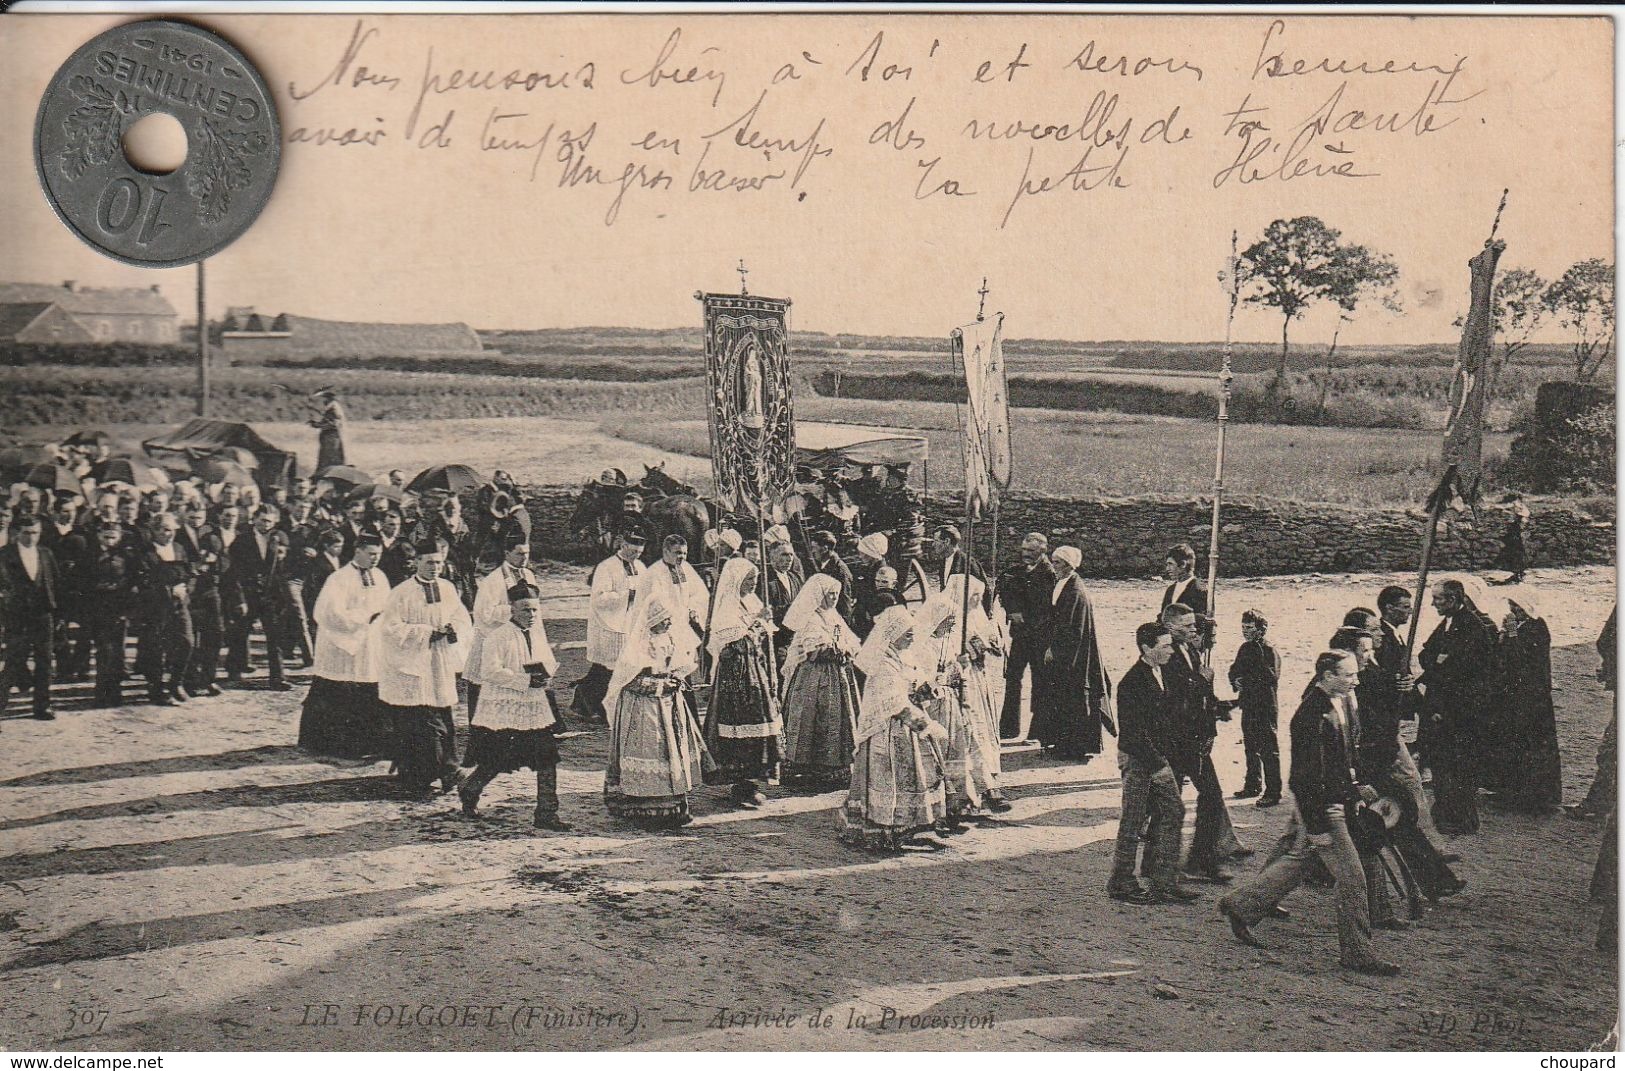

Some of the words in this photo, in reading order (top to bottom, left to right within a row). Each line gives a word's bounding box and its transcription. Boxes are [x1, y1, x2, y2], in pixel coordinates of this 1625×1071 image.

[94, 50, 261, 124] CENTIMES
[158, 44, 213, 76] 1941
[289, 20, 397, 100] Nous
[405, 46, 596, 140] pensons
[620, 27, 727, 107] bien
[772, 50, 823, 85] à
[846, 31, 940, 83] toi
[973, 43, 1032, 83] et
[1070, 40, 1204, 80] serons
[286, 117, 387, 147] avoir
[419, 110, 451, 150] de
[632, 131, 680, 155] en
[702, 89, 834, 189] temps
[869, 97, 926, 150] des
[1140, 106, 1194, 144] de
[1222, 94, 1271, 137] ta
[96, 177, 172, 248] 10
[604, 161, 673, 226] gros
[914, 157, 976, 199] Ta
[1001, 145, 1130, 229] petite
[1213, 124, 1381, 189] Hélène
[65, 1008, 109, 1034] 307
[298, 1004, 342, 1027] LE
[354, 1004, 507, 1028] FOLGOET
[705, 1006, 796, 1029] Arrivée
[808, 1006, 833, 1030] de
[846, 1006, 868, 1030] la
[879, 1006, 996, 1030] Procession
